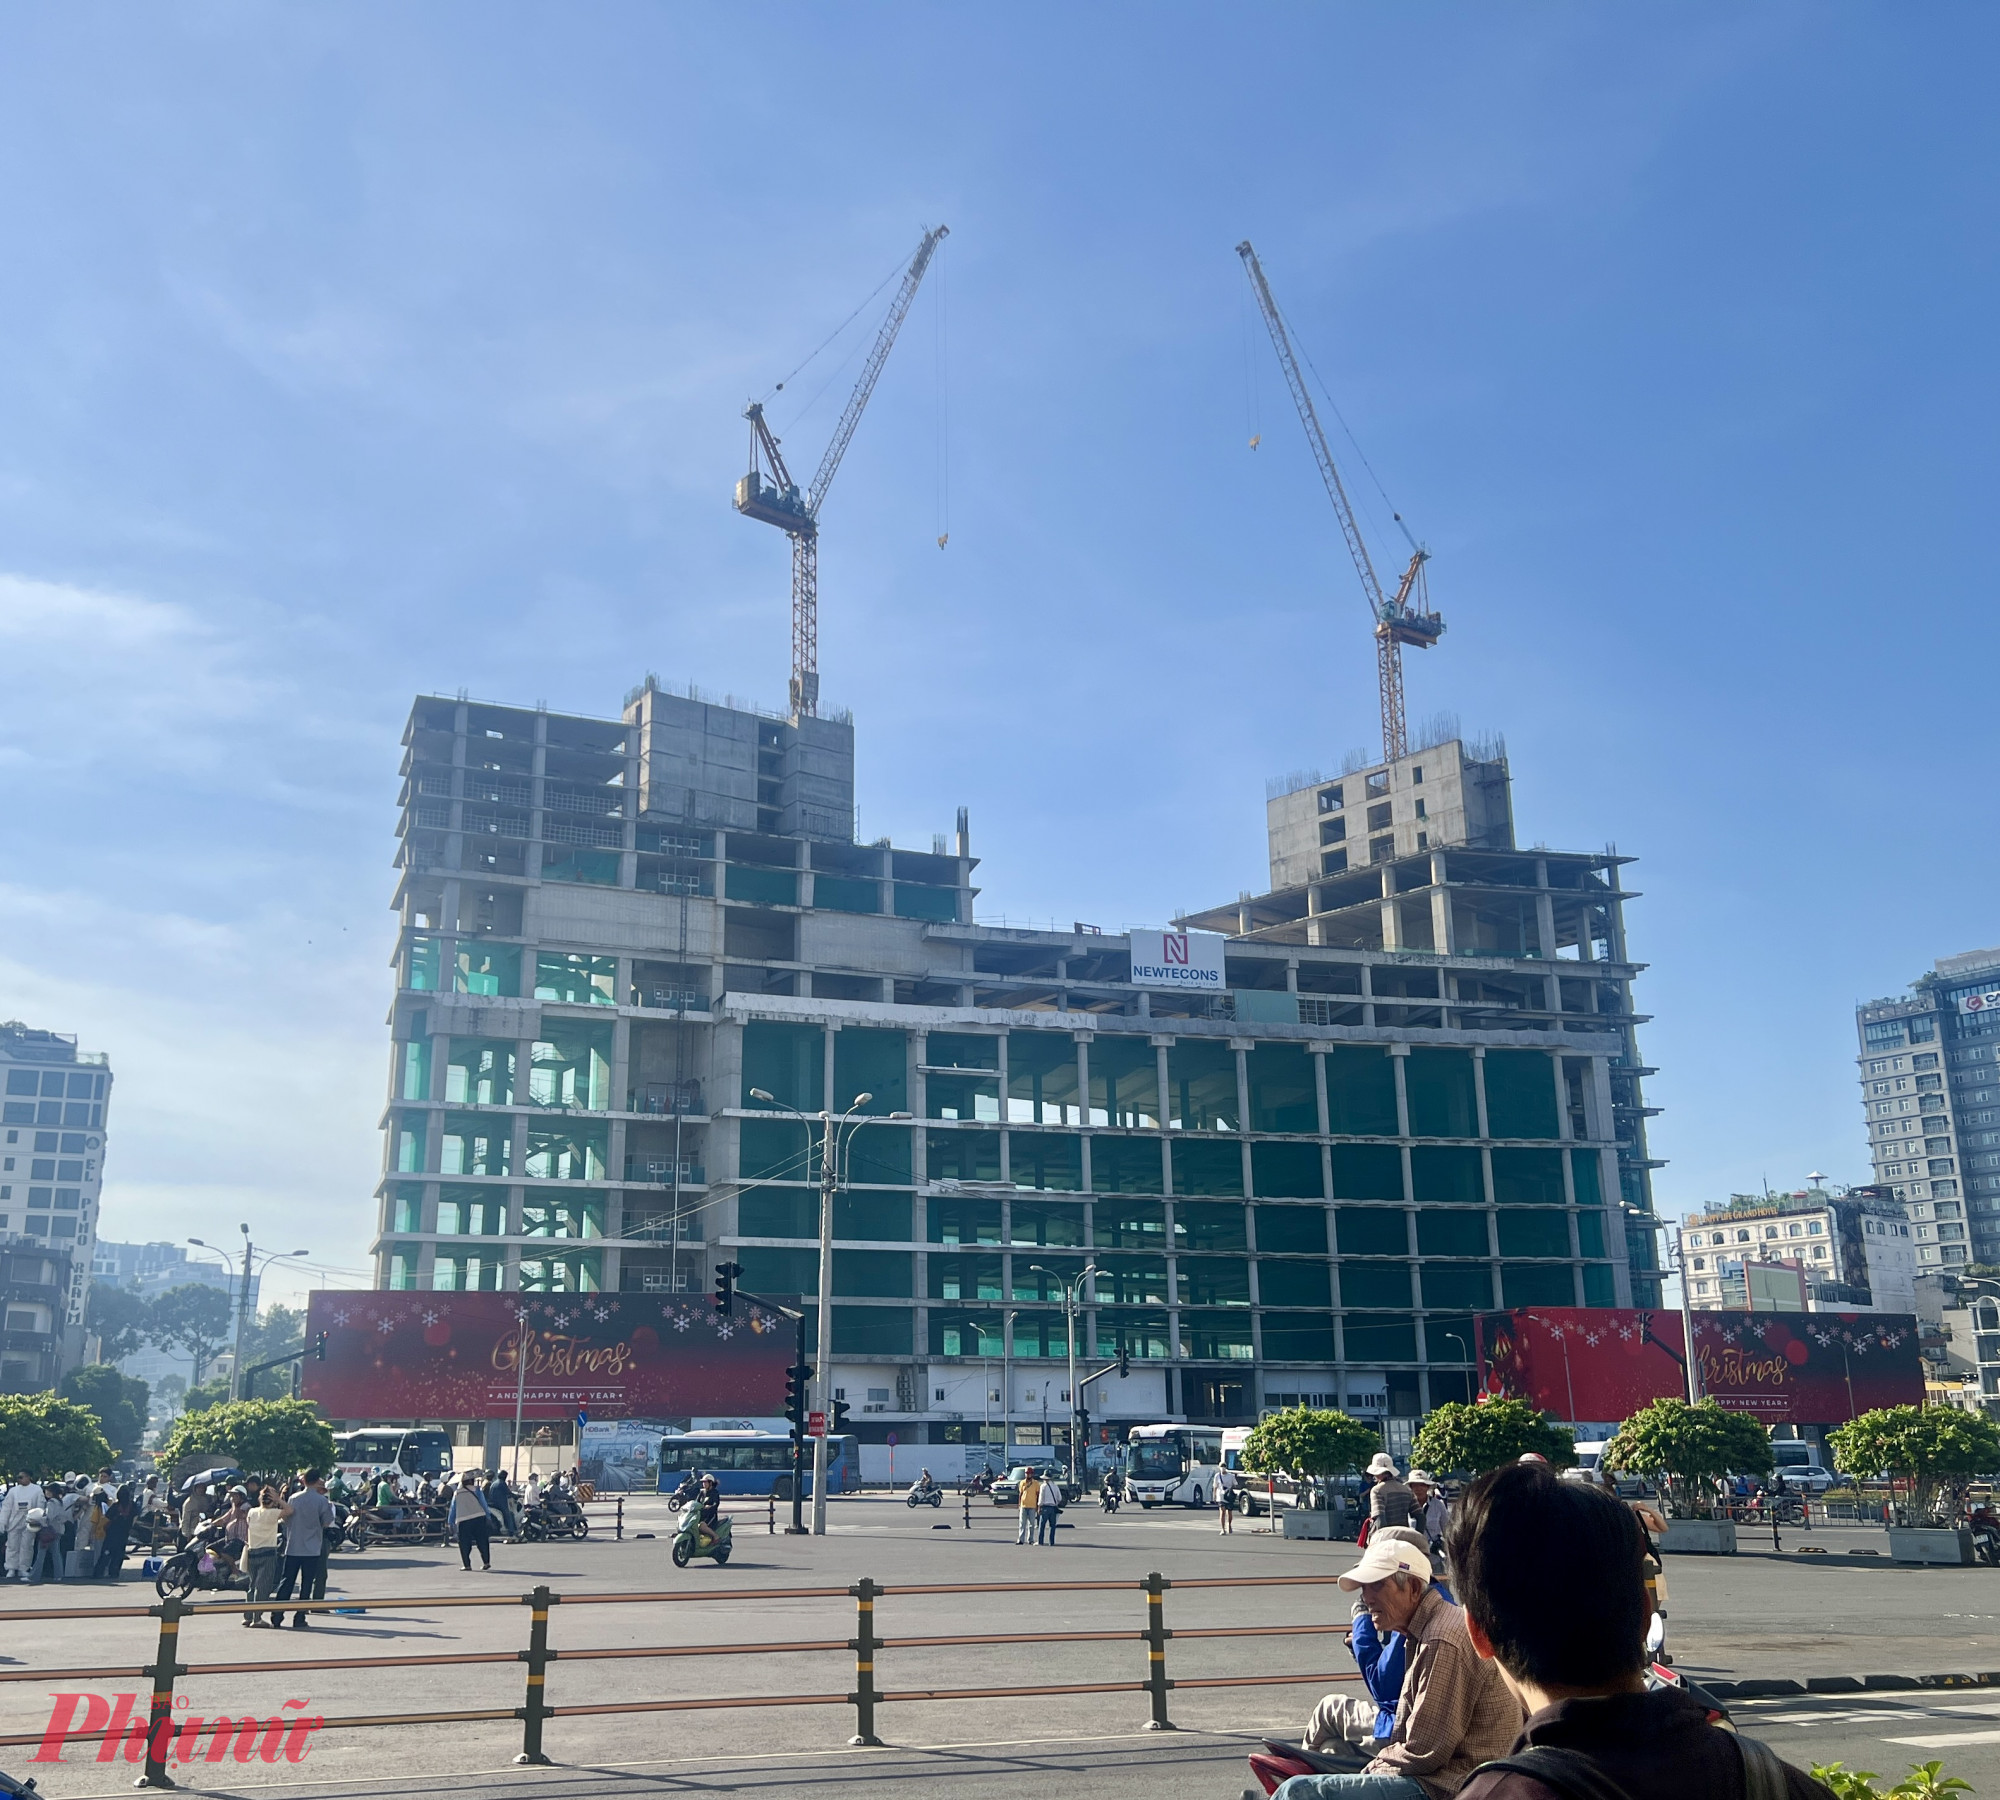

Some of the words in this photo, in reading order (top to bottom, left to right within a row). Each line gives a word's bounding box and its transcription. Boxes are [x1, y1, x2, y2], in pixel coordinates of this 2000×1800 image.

[1134, 965, 1219, 981] NEWTECONS
[67, 1262, 84, 1324] REALM
[491, 1329, 632, 1376] Christmas
[1680, 1344, 1788, 1385] hristmas
